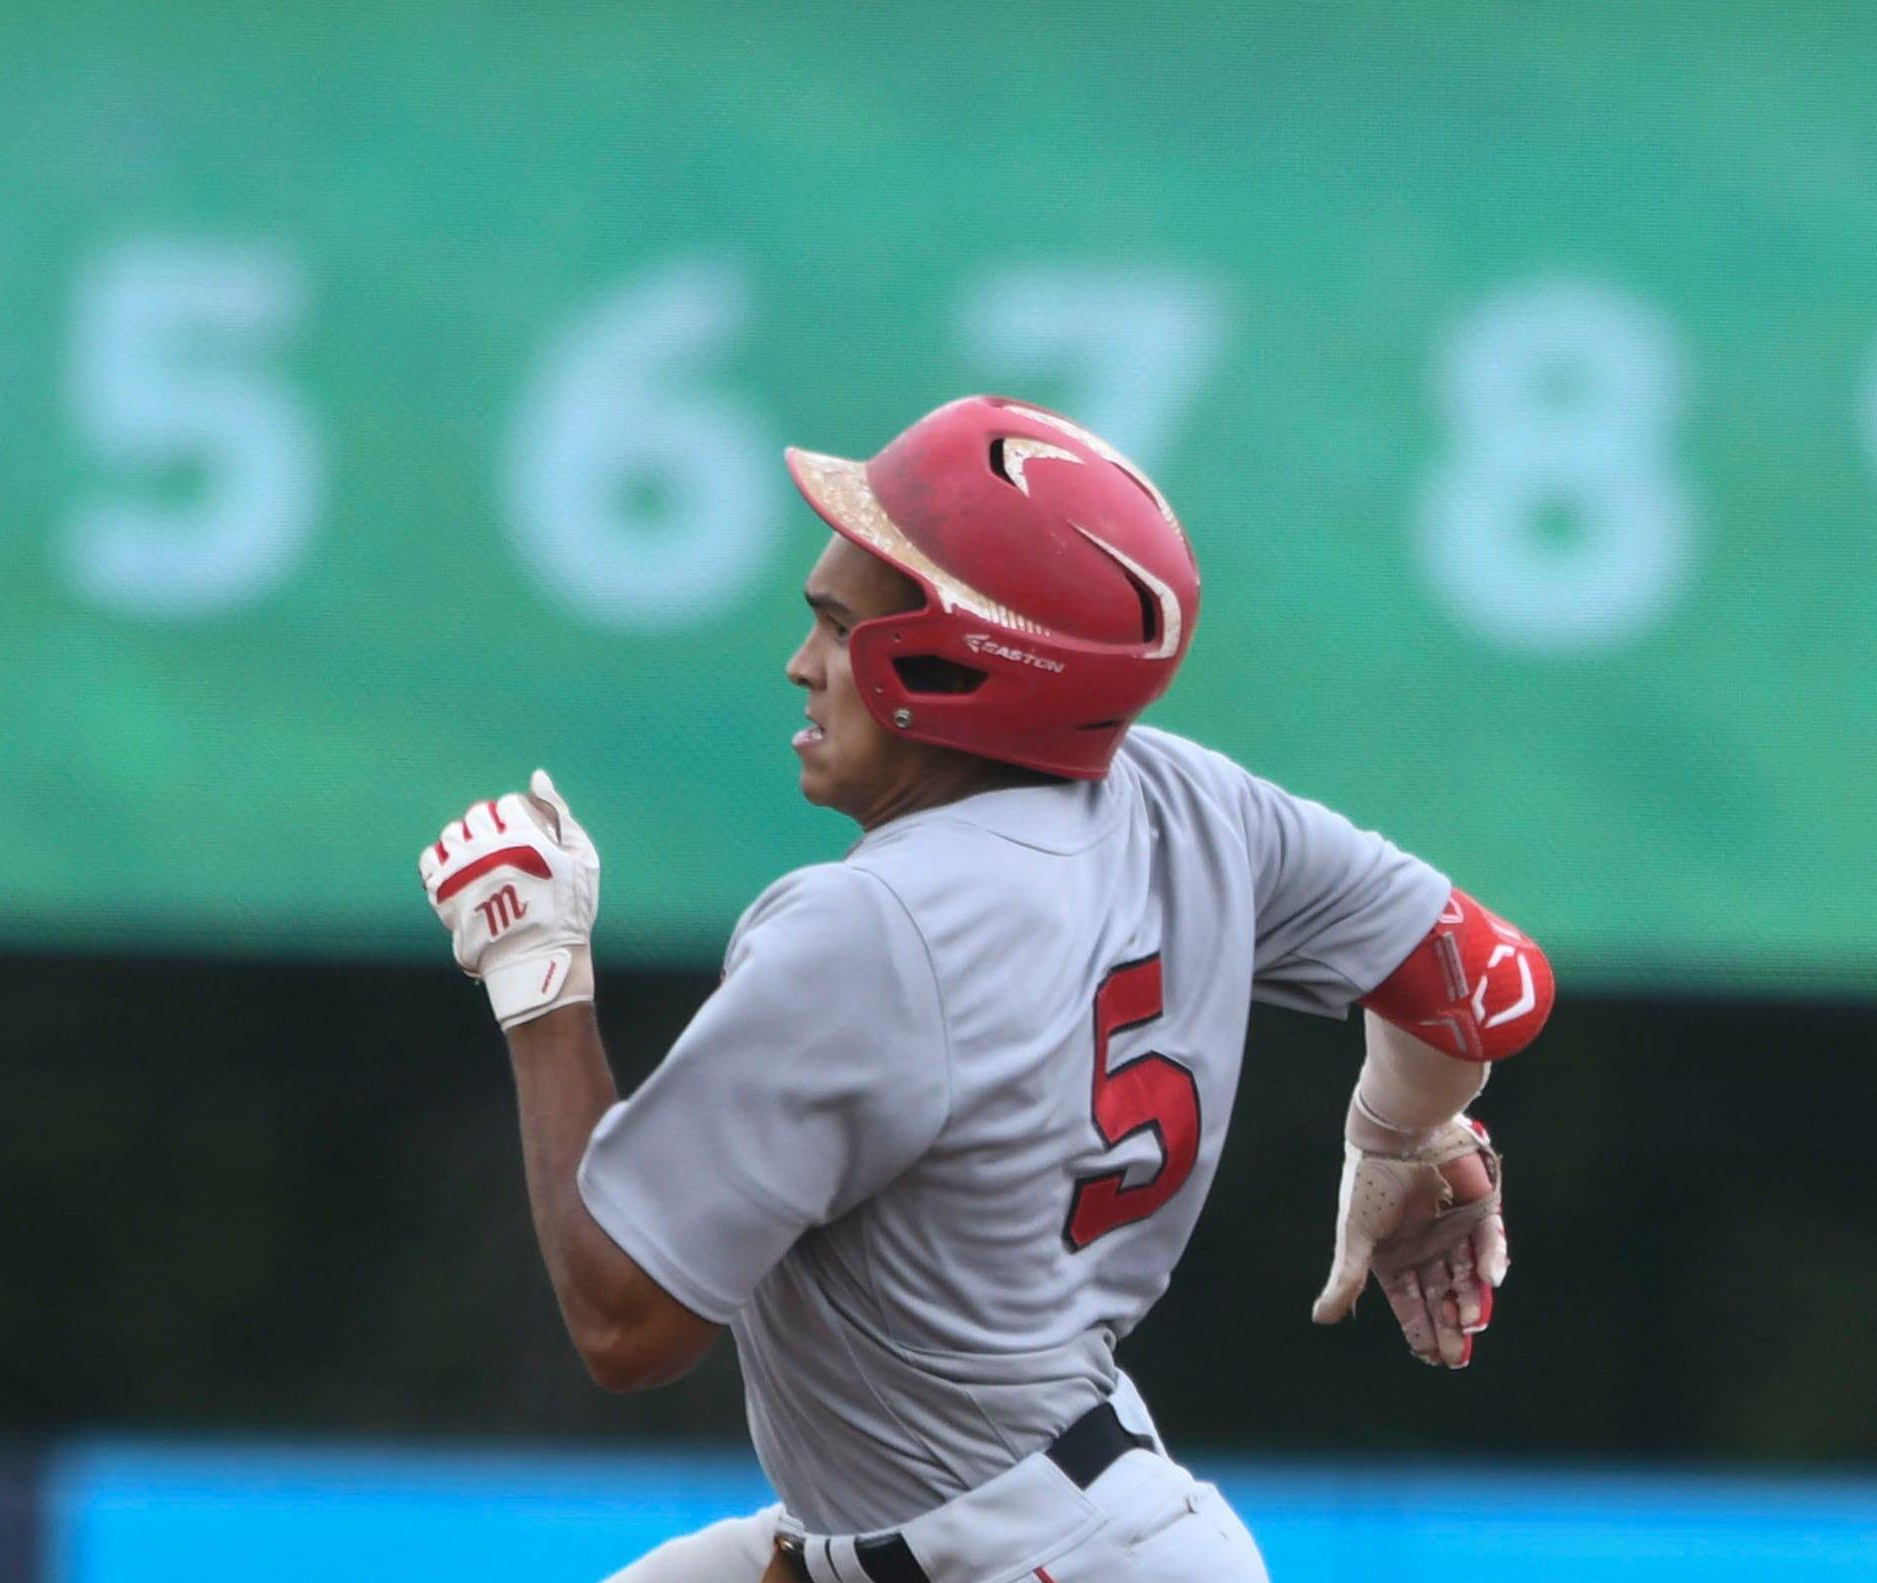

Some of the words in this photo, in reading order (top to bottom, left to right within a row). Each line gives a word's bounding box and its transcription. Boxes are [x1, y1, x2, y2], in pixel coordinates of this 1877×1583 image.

[65, 237, 321, 609] 5
[506, 260, 780, 627] 6
[953, 267, 1228, 487] 7
[1418, 278, 1697, 653] 8
[981, 641, 1066, 674] EASTON
[1061, 950, 1202, 1256] 5
